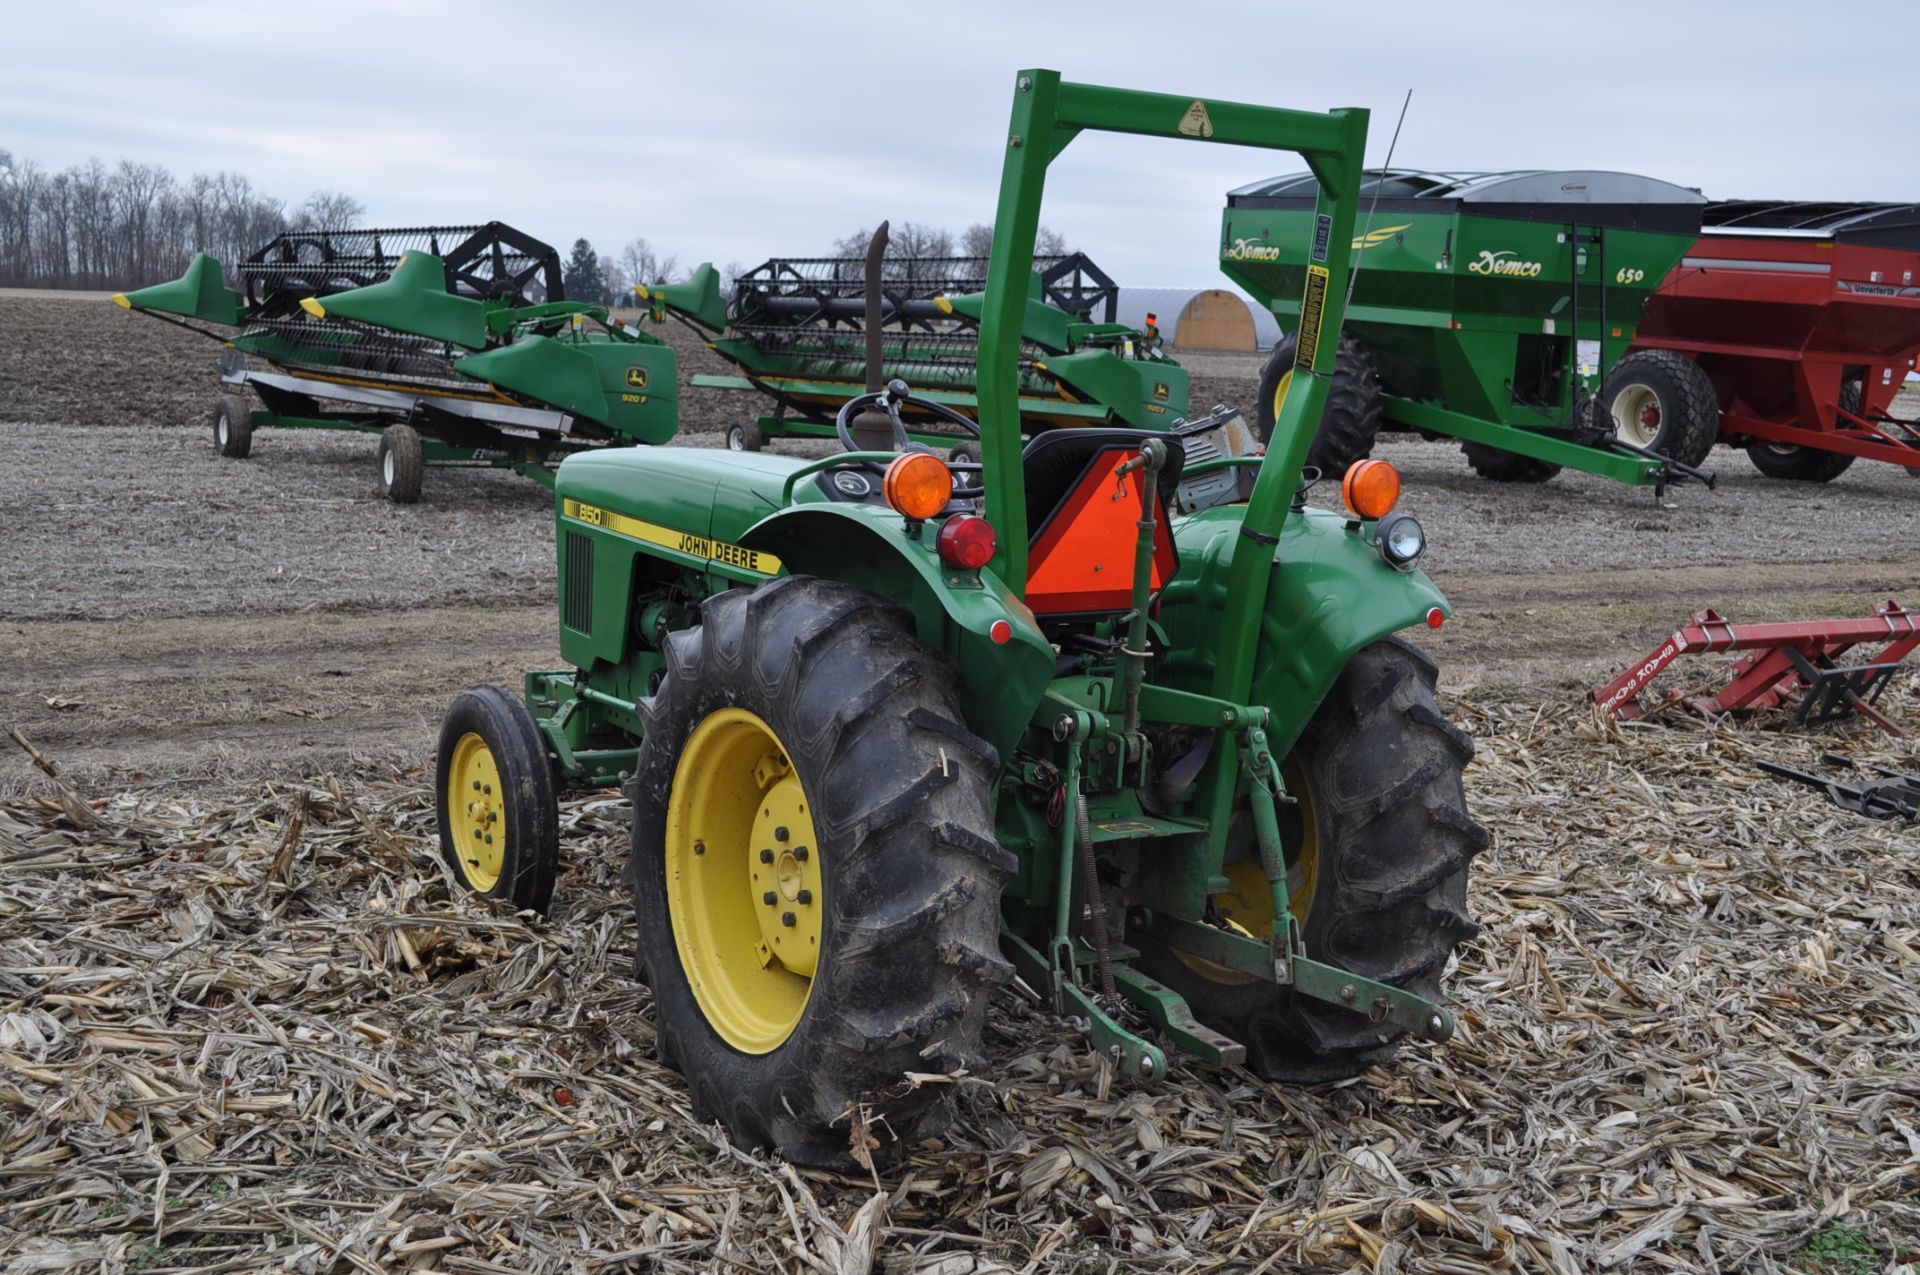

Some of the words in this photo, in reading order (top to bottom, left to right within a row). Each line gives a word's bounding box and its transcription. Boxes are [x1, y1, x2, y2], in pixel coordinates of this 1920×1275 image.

[1230, 237, 1280, 261] Demco
[1468, 250, 1542, 277] Demco
[1616, 267, 1644, 285] 650
[622, 393, 640, 403] 920
[640, 395, 648, 404] F
[578, 505, 602, 524] 850
[678, 534, 709, 557] JOHN
[715, 544, 759, 570] DEERE
[1636, 644, 1675, 682] STACK
